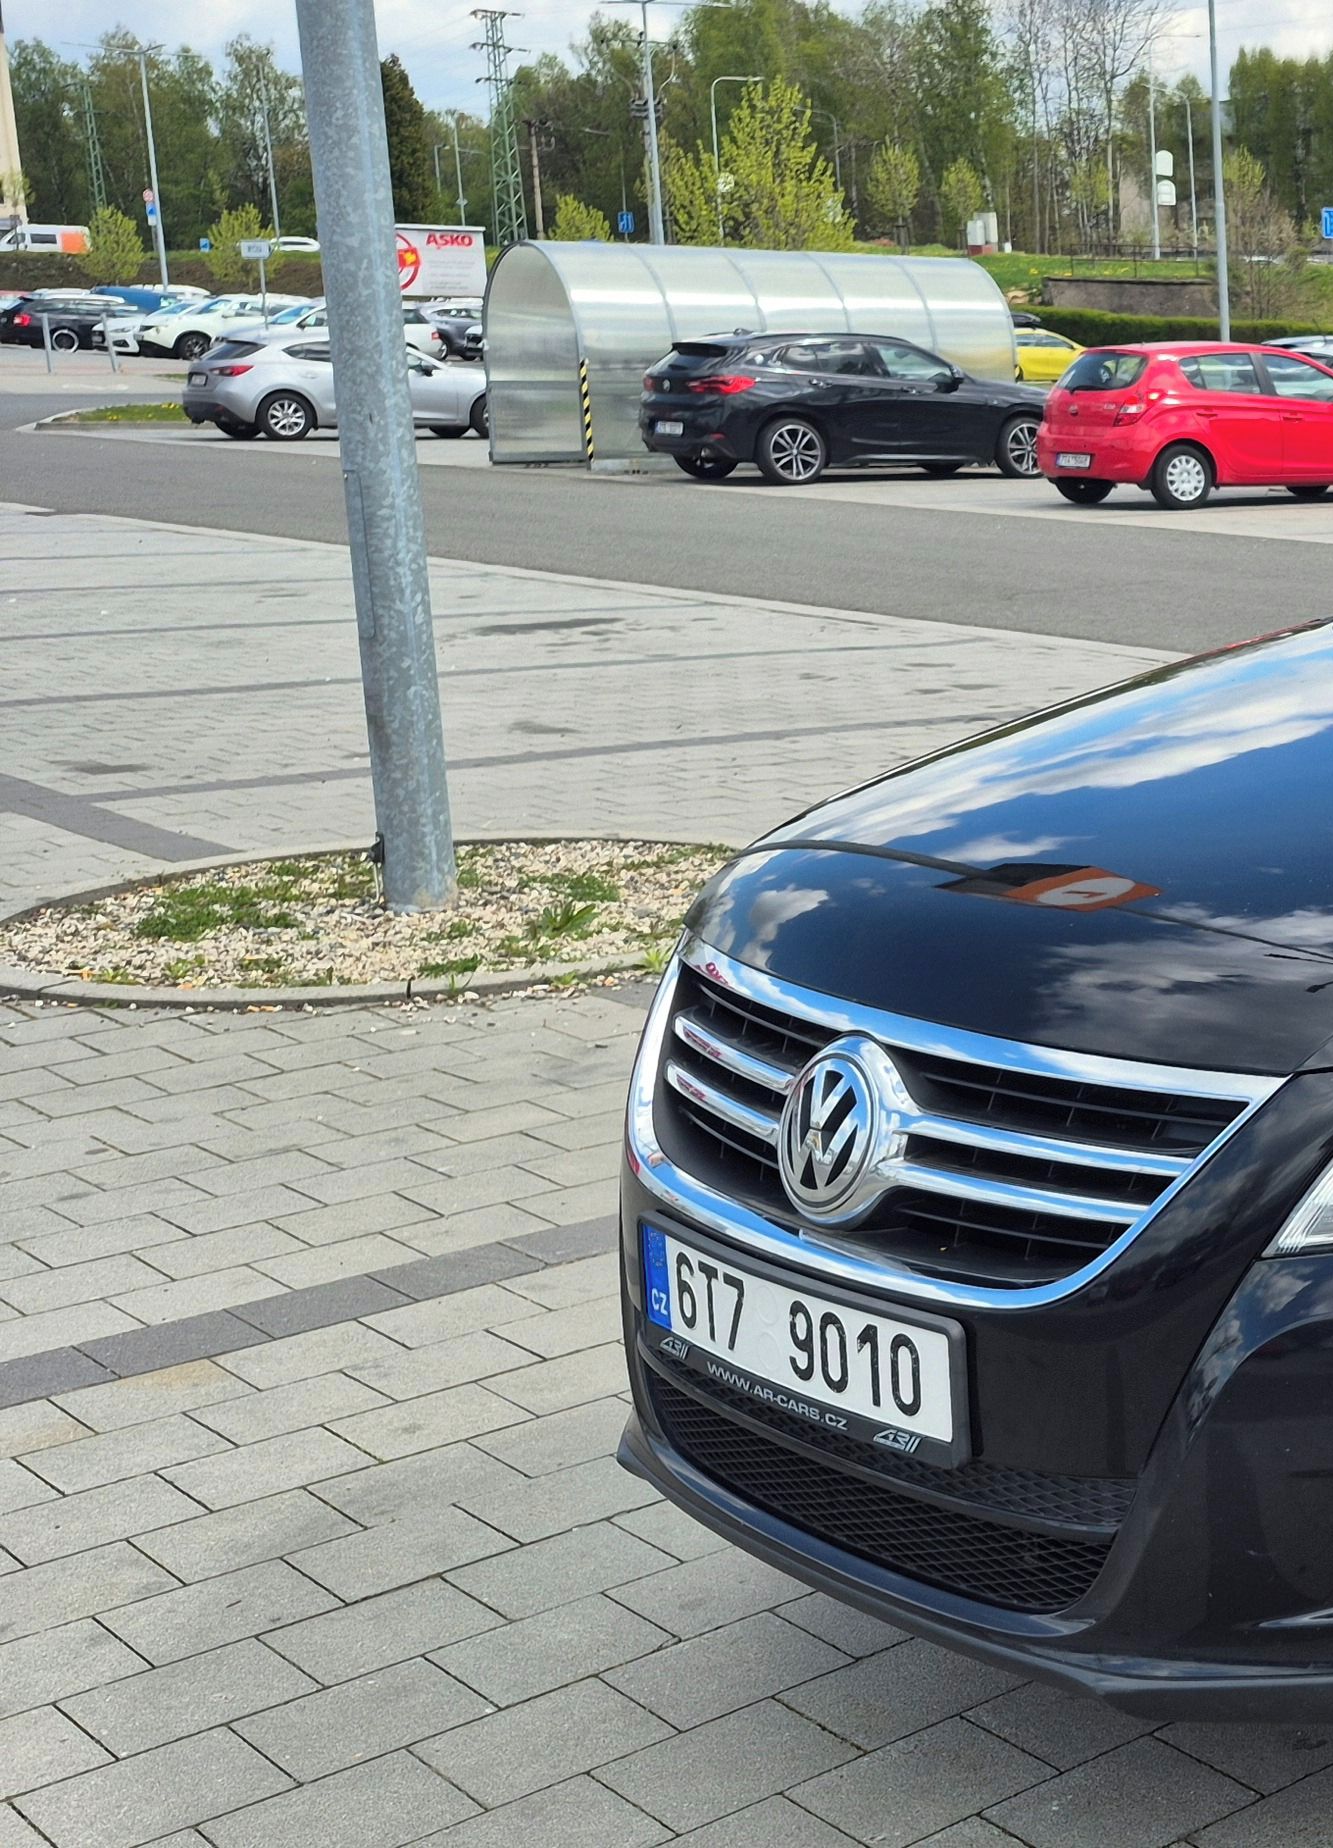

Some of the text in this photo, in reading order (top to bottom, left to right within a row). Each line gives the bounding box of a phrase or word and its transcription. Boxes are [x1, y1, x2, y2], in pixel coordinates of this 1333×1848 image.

[426, 233, 473, 247] ASKO
[651, 1288, 668, 1316] CZ
[676, 1251, 921, 1416] 6T7 9010
[706, 1361, 848, 1430] WWW.AR-CARS.CZ
